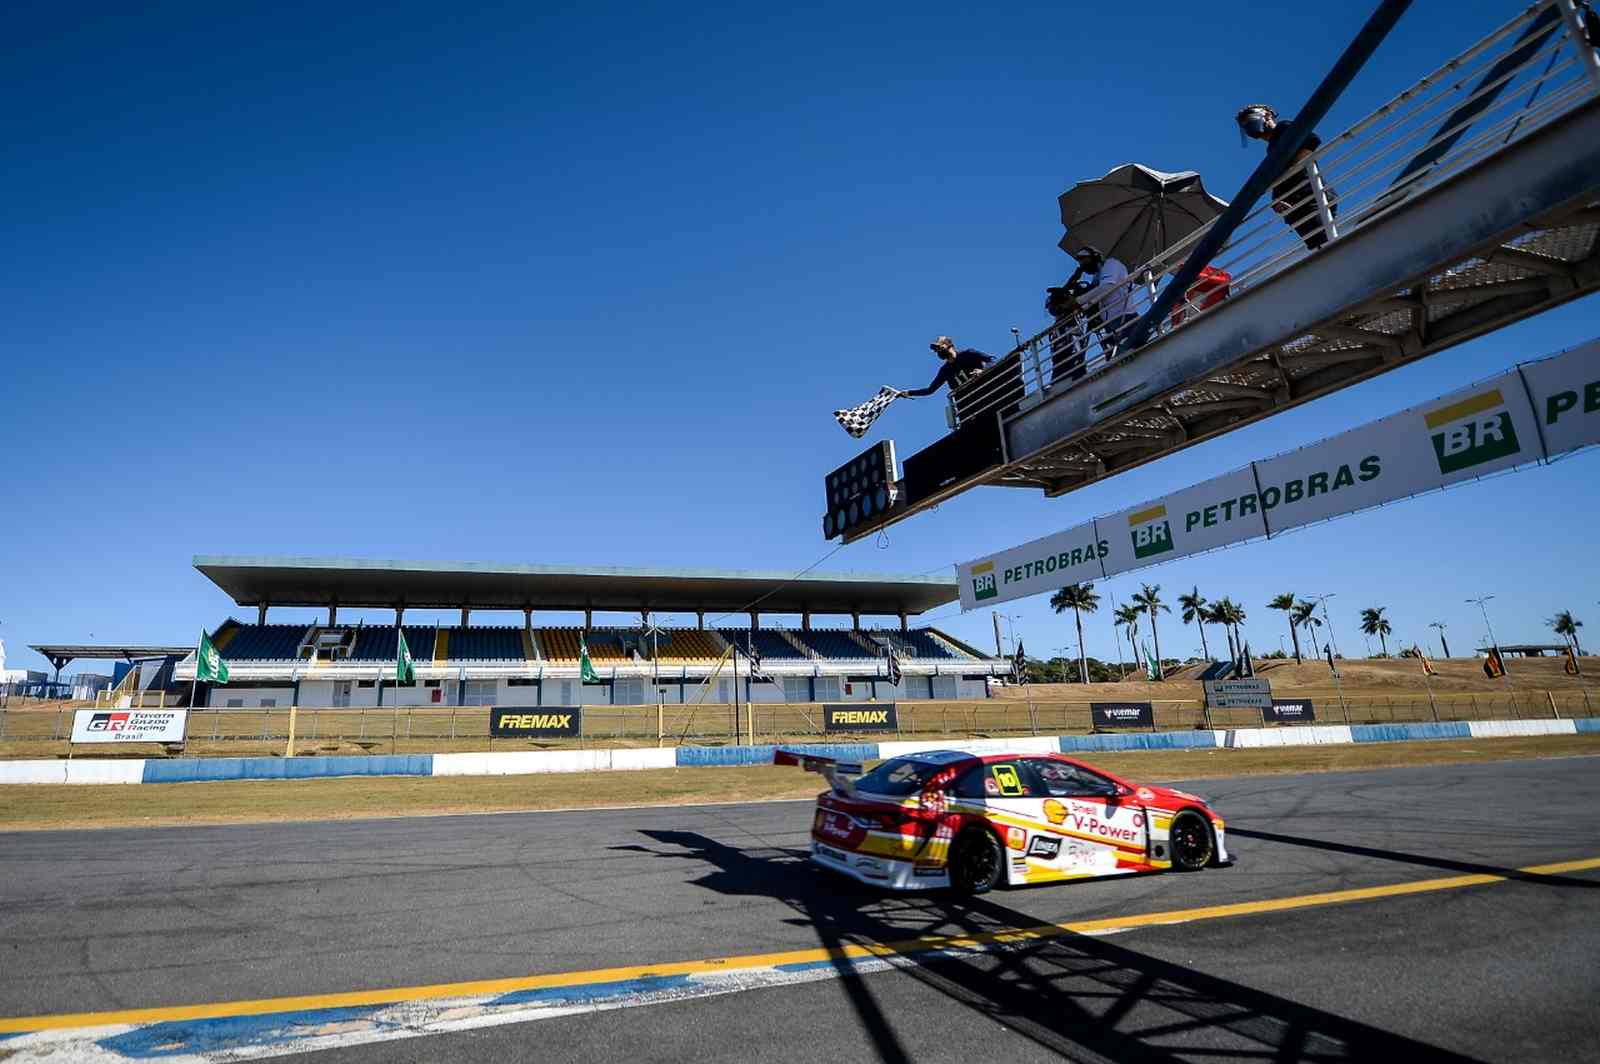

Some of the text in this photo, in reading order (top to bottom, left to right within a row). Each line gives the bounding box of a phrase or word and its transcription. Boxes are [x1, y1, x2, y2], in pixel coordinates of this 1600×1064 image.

[1443, 413, 1505, 457] BR
[1185, 455, 1381, 532] PETROBRAS
[1135, 522, 1167, 548] BR
[1003, 540, 1109, 584] PETROBRAS
[975, 573, 995, 592] BR
[499, 715, 571, 729] FREMAX
[831, 711, 889, 724] FREMAX
[998, 772, 1015, 787] 10
[1073, 815, 1137, 841] V-Power
